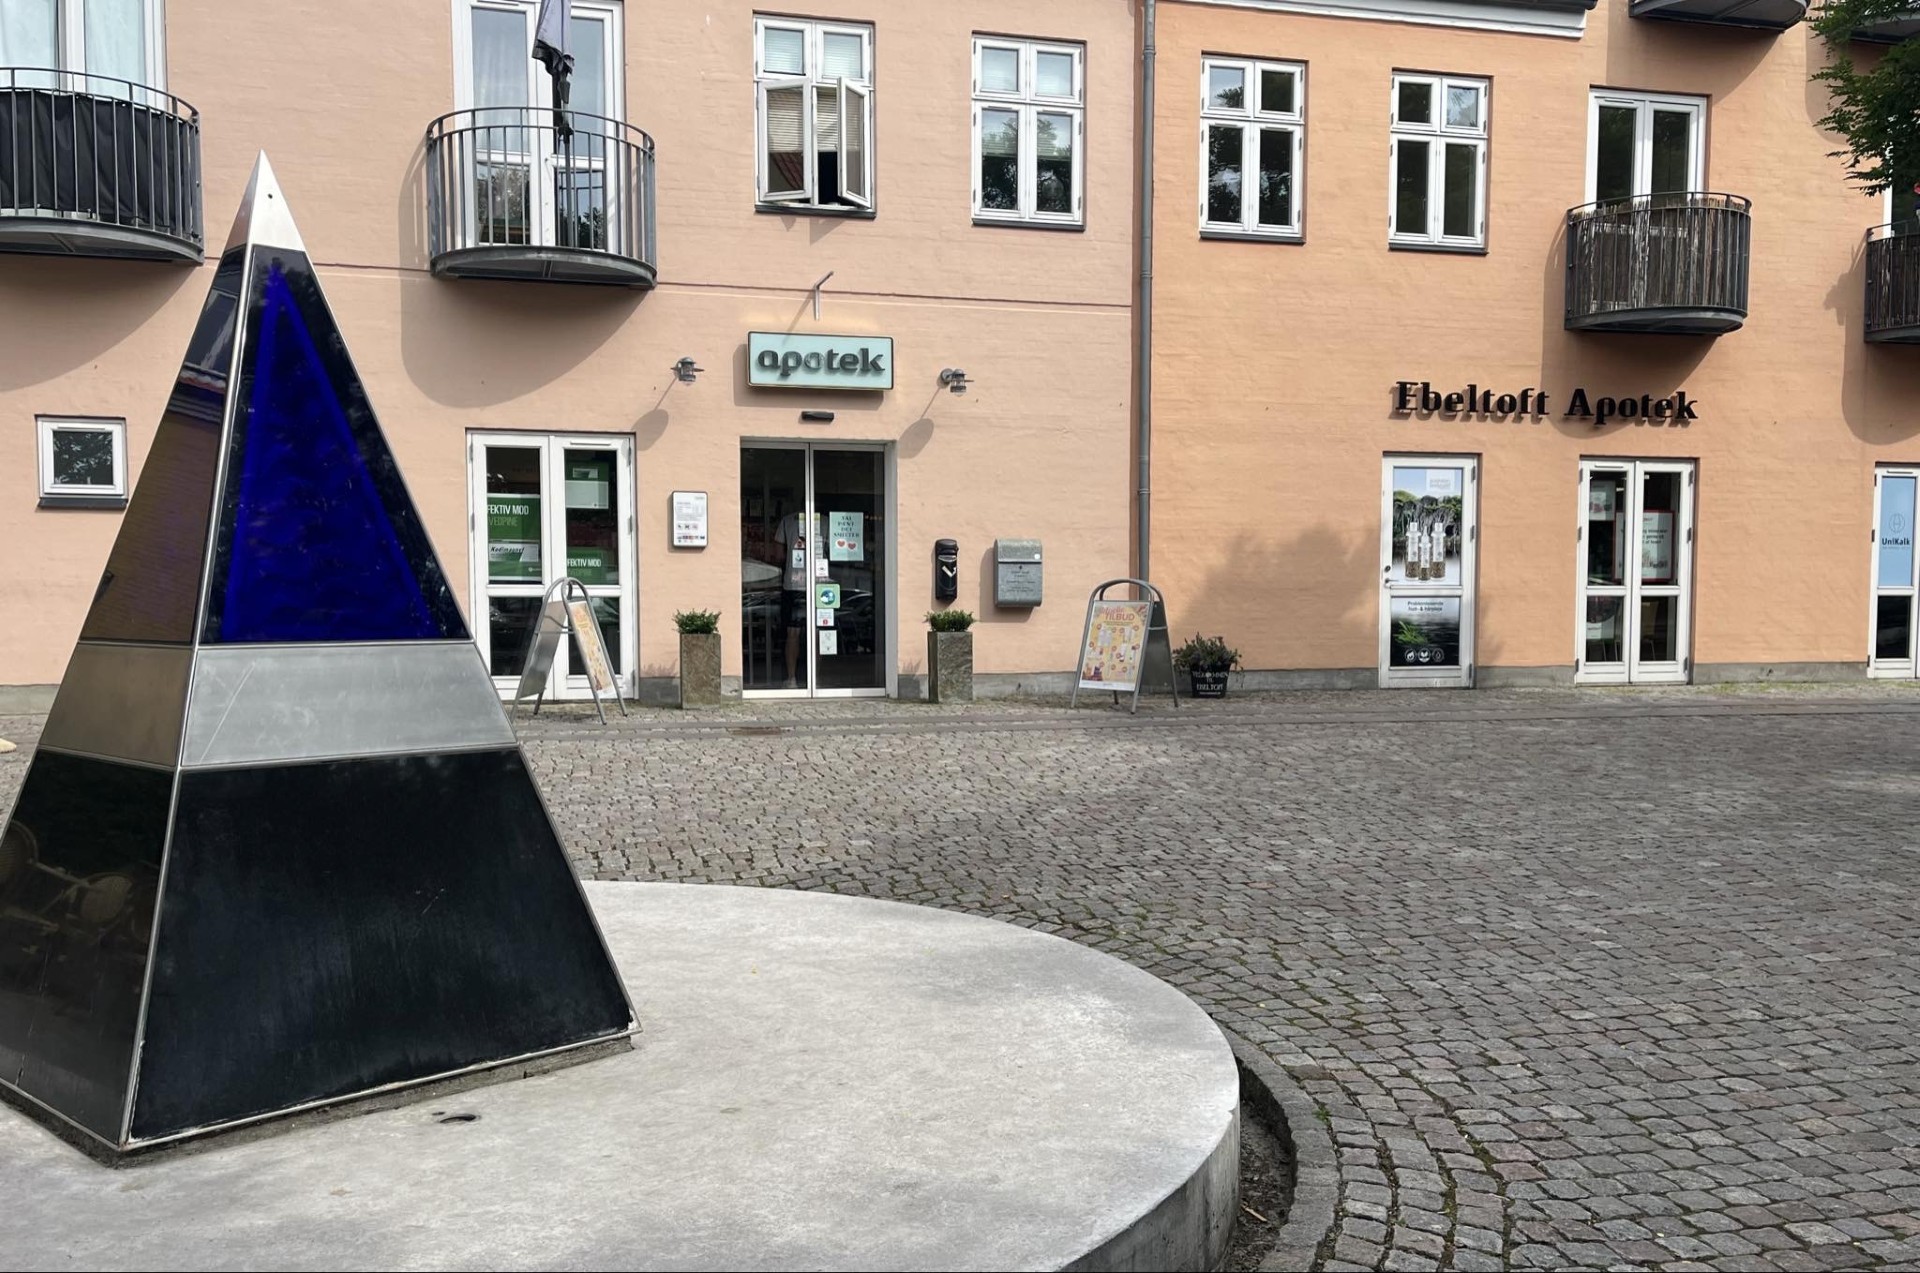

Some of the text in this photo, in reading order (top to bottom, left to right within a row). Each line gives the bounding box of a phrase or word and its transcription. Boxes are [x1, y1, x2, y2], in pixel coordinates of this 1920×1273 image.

[757, 347, 886, 377] apotek
[1396, 381, 1699, 425] Ebeltoft Apotek
[512, 505, 530, 515] MOD
[1881, 537, 1910, 546] UniKalk
[587, 558, 602, 567] MOD
[1105, 612, 1135, 621] TILBUD
